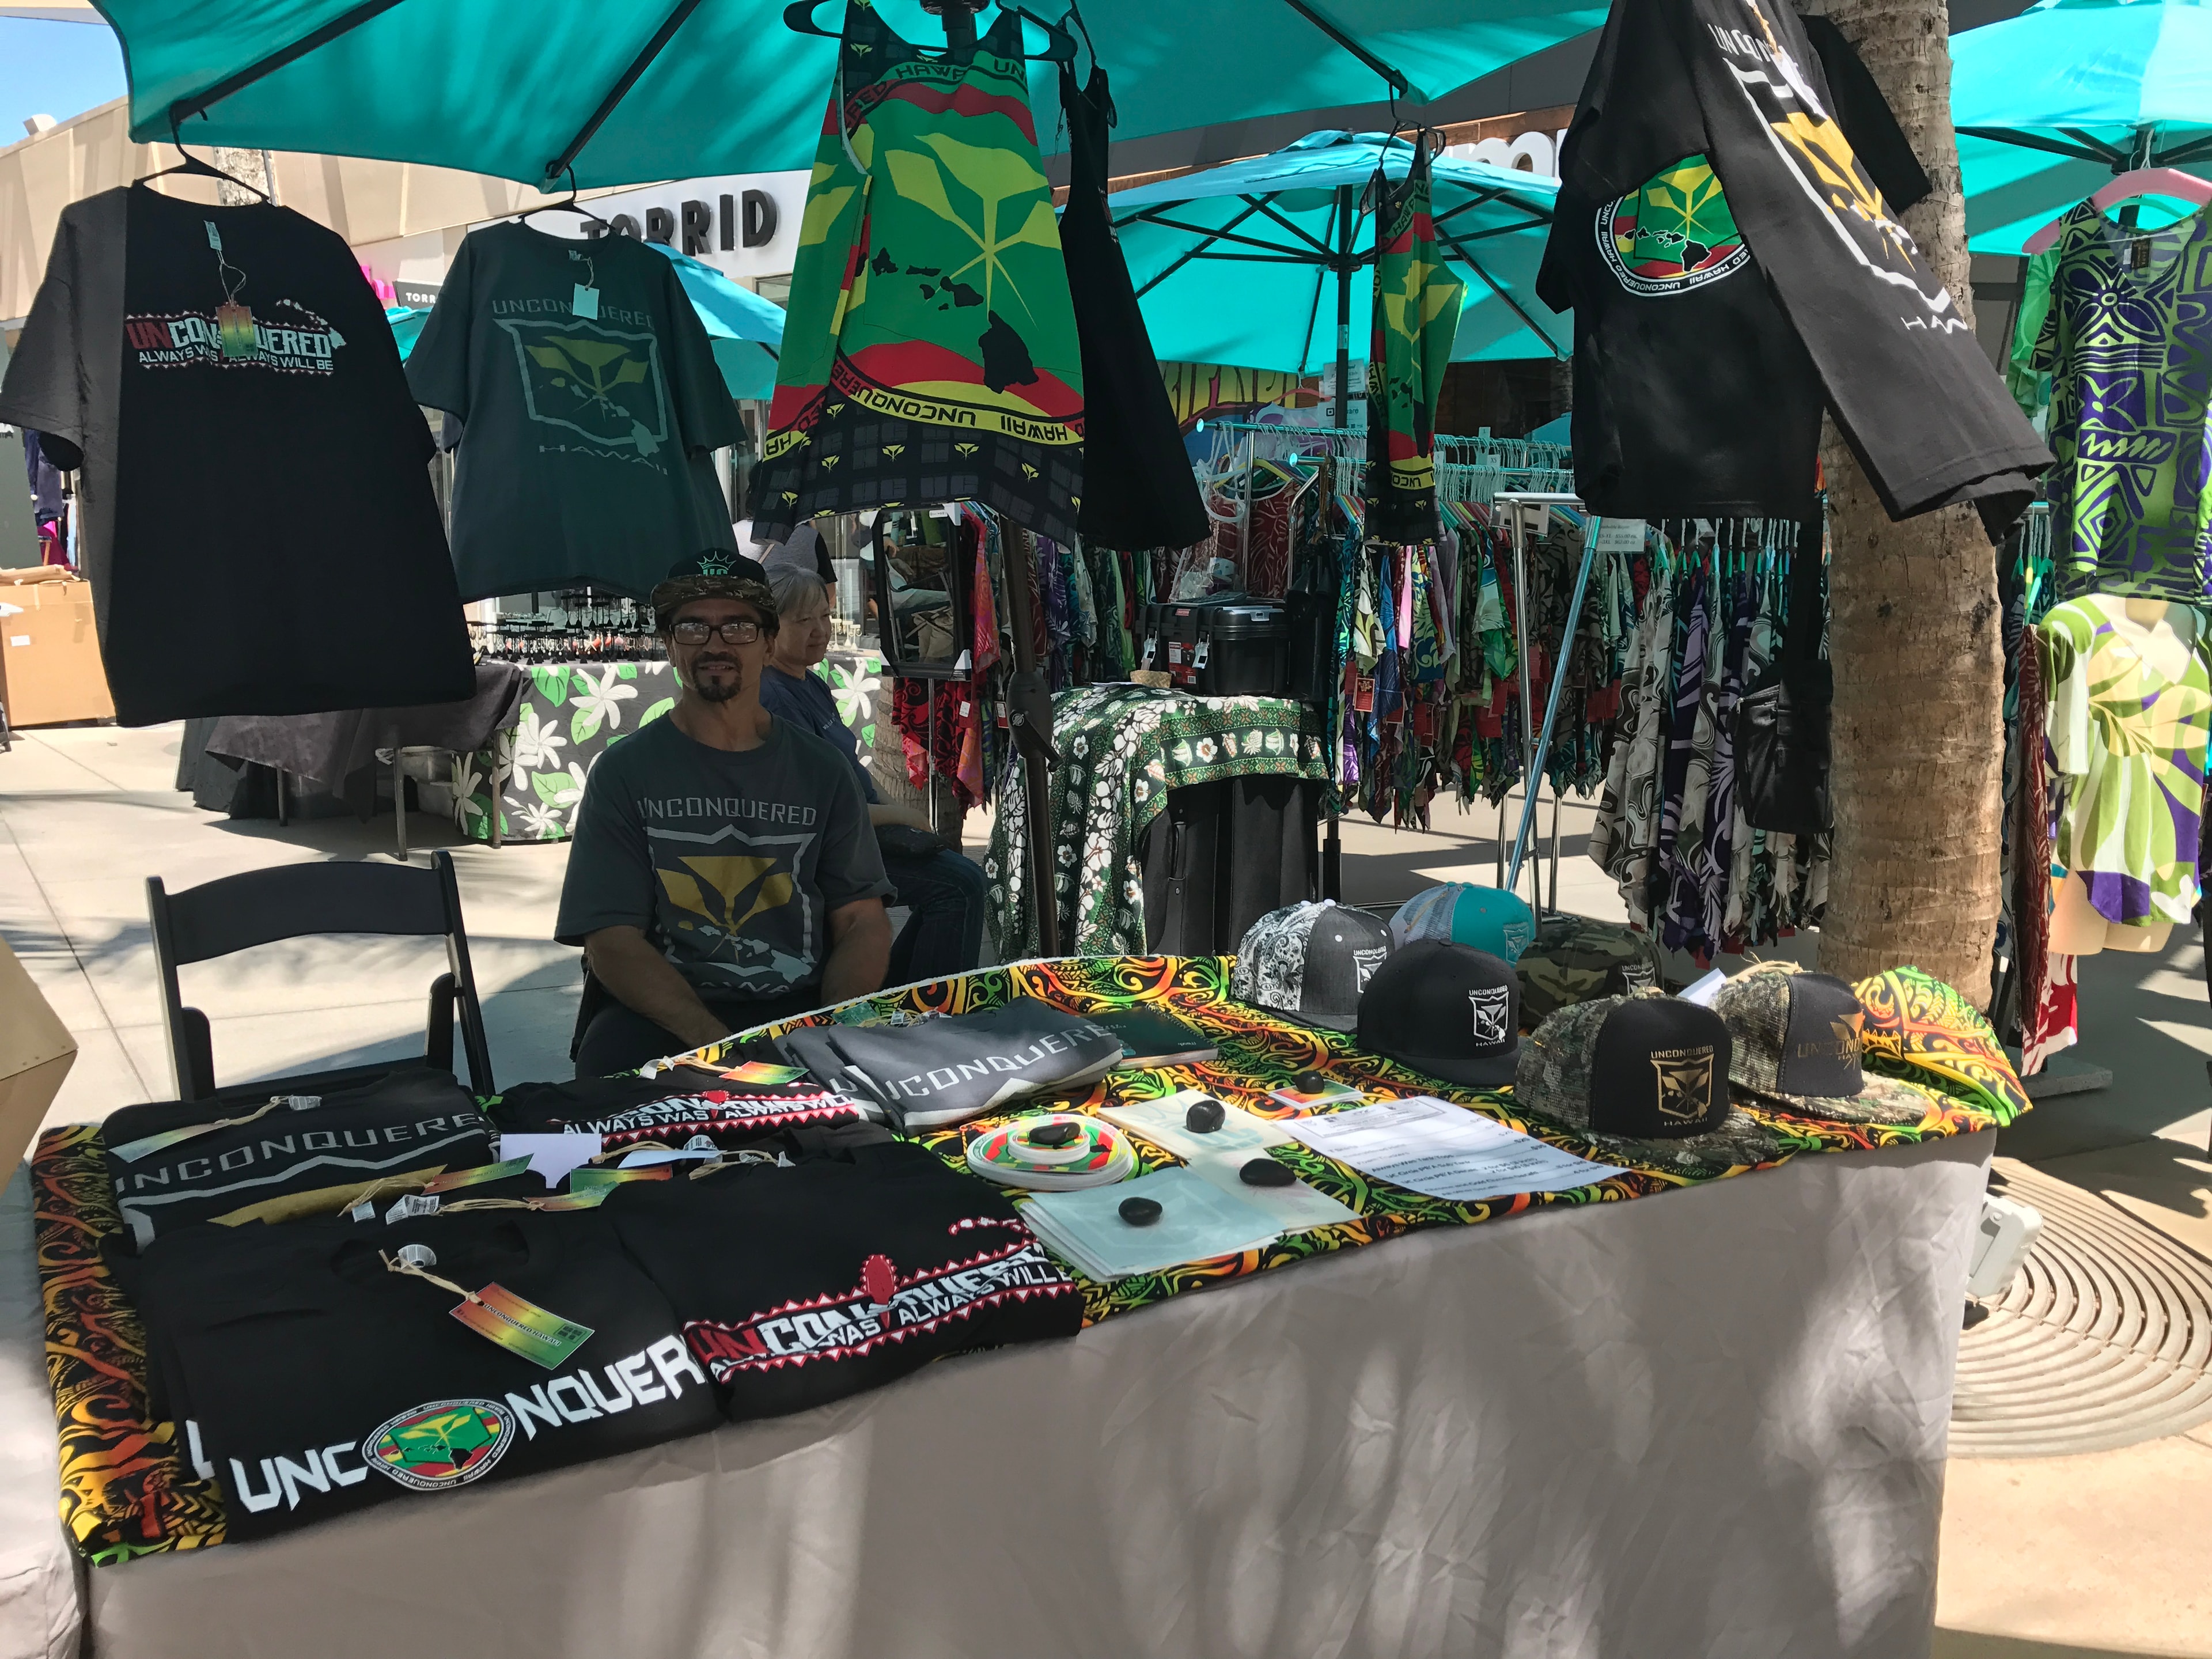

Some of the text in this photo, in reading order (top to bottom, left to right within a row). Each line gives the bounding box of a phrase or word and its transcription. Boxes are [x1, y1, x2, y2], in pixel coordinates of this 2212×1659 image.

[580, 189, 777, 256] TORRID
[1690, 264, 1730, 285] HAWAII
[126, 317, 332, 358] UNCONUERED
[139, 349, 194, 363] ALWAYS
[279, 357, 315, 370] WILL
[316, 359, 334, 371] BE
[1469, 984, 1508, 995] UNCONQUERED
[1650, 1045, 1714, 1059] UNCONQUERED
[653, 1109, 710, 1124] WAS
[1664, 1117, 1707, 1126] HAWAII
[484, 1304, 532, 1333] UNCONQUERED
[532, 1330, 562, 1347] HAWAII
